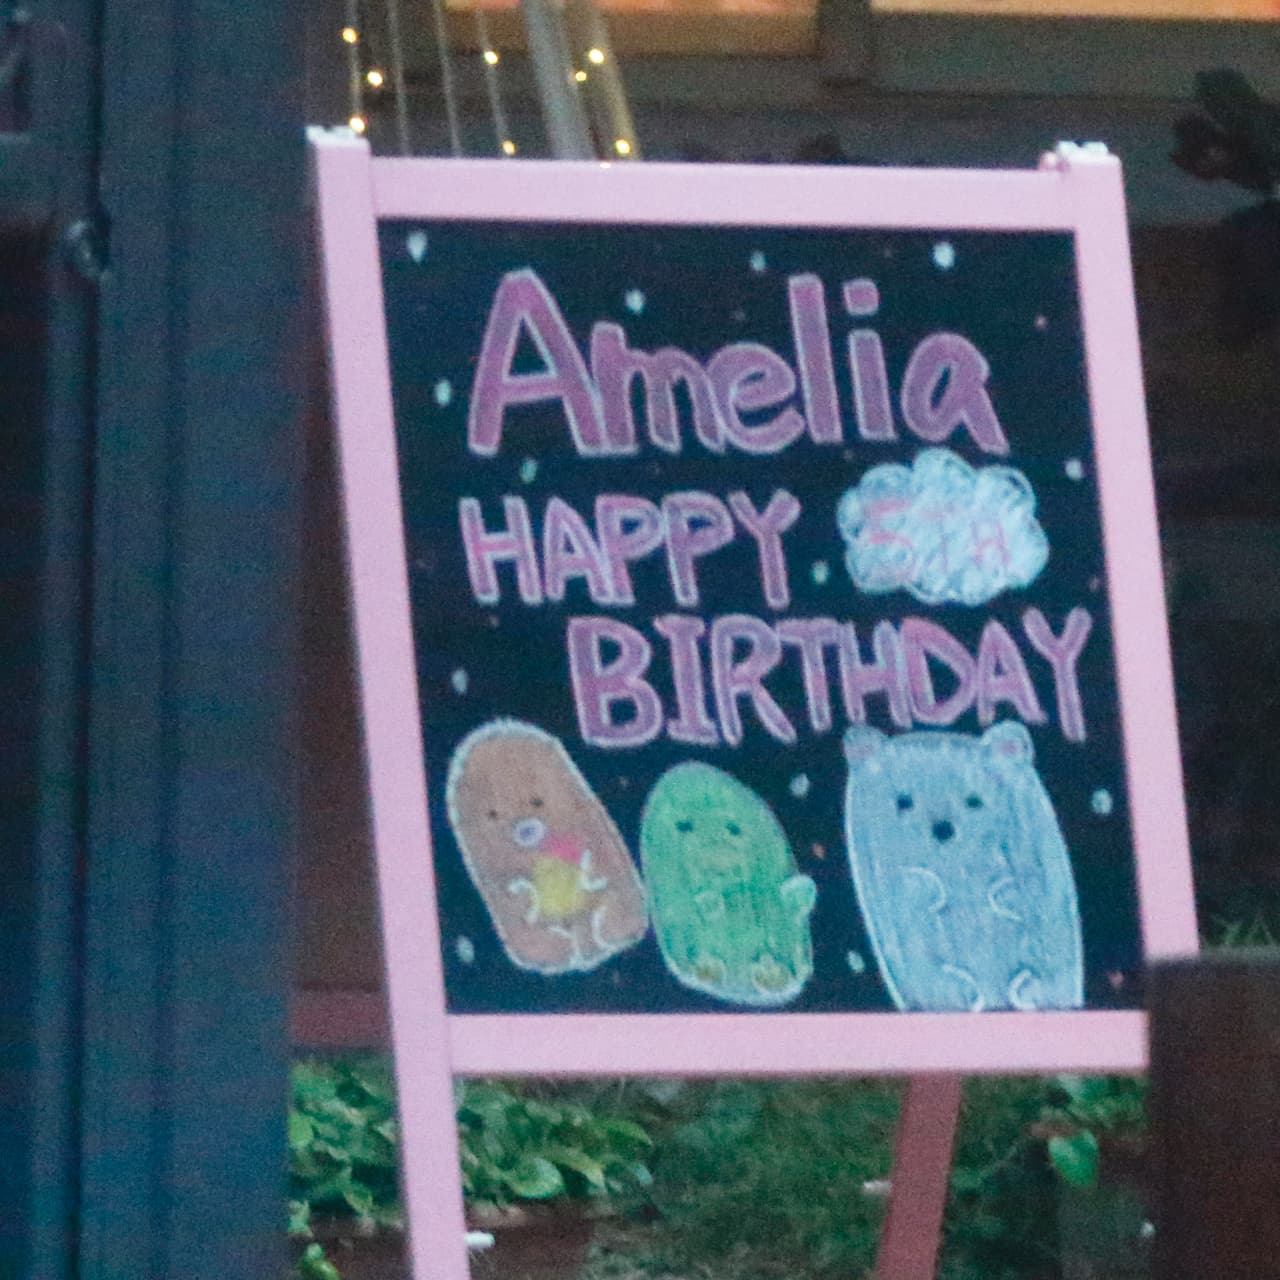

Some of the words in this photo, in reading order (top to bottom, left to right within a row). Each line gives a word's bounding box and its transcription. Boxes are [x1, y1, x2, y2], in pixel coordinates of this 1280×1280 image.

[468, 267, 1009, 458] Amelia
[458, 489, 800, 607] HAPPY
[566, 607, 1092, 748] BIRTHDAY
